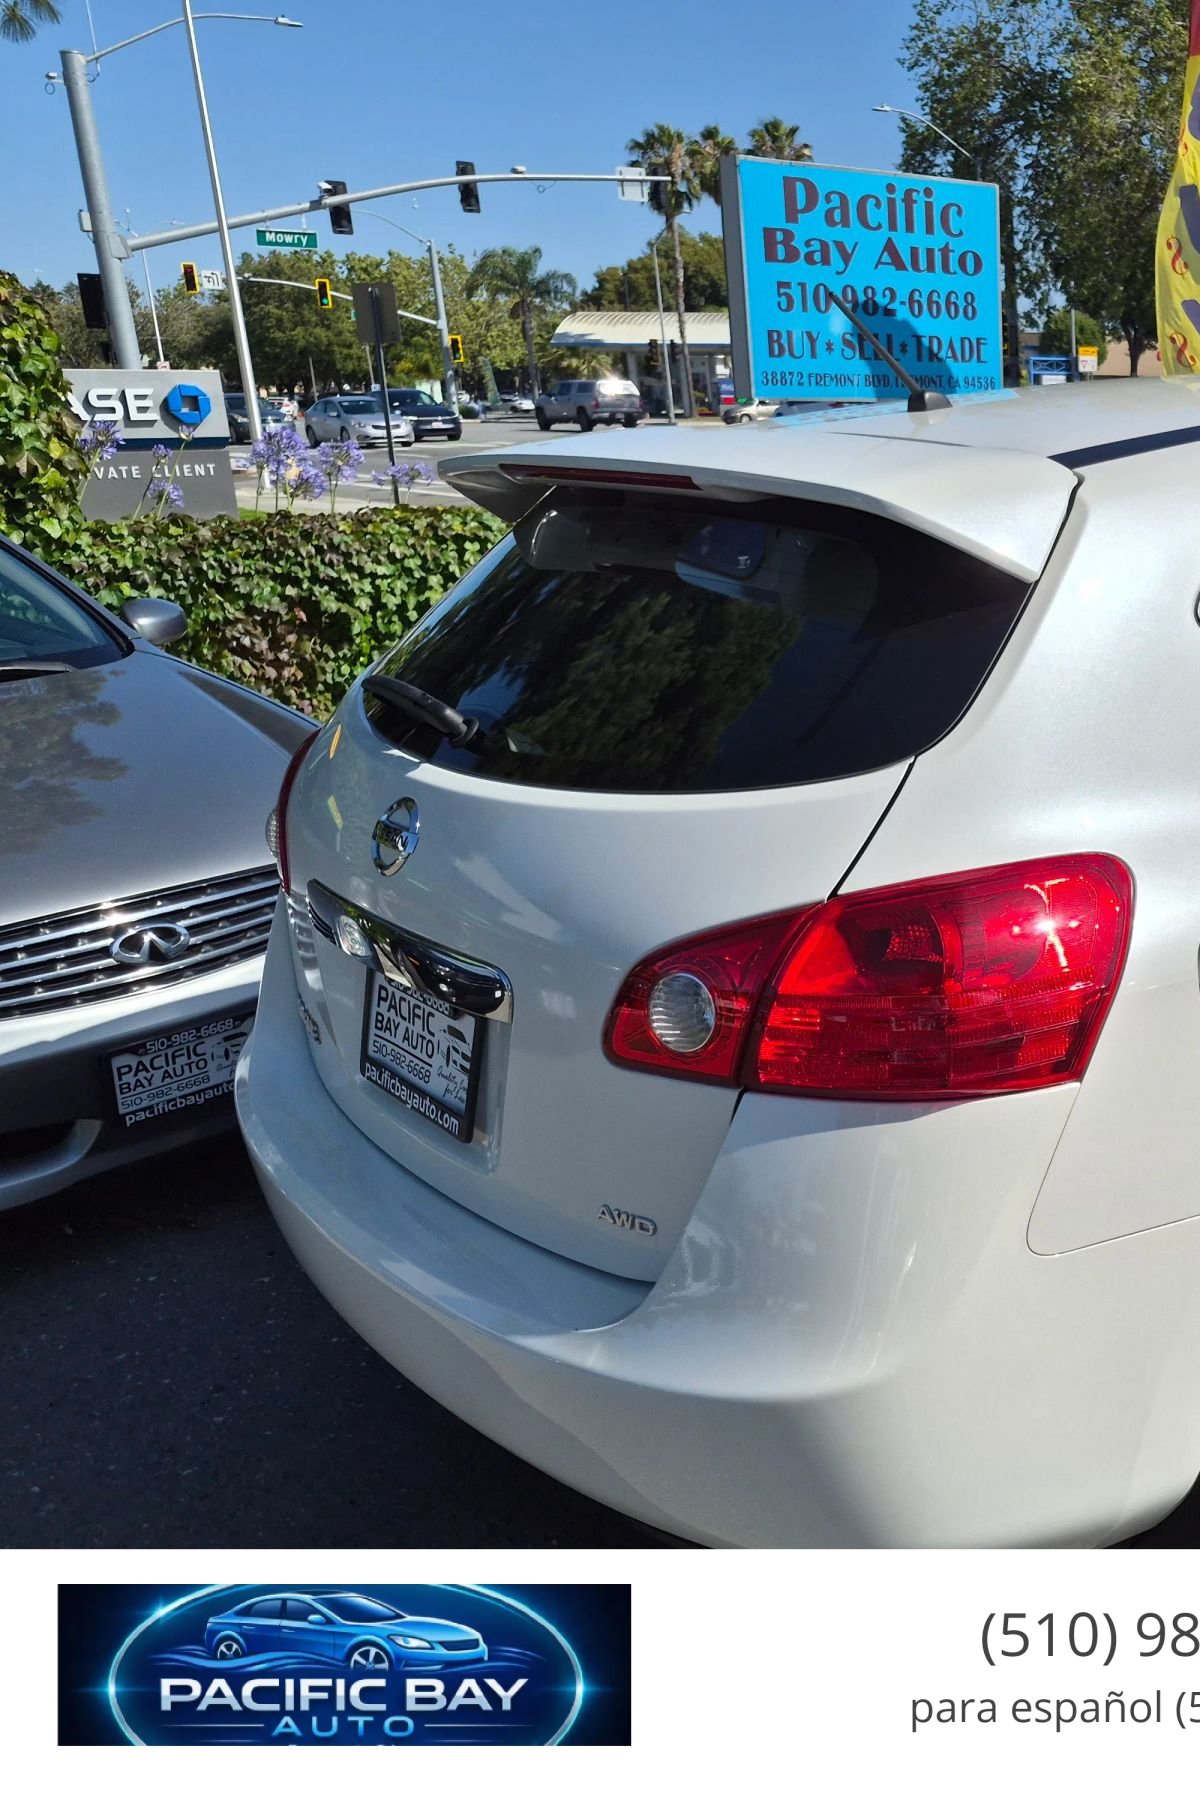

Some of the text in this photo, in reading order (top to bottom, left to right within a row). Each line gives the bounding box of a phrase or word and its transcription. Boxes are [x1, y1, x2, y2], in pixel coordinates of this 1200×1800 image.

[783, 176, 964, 238] Pacific
[265, 231, 308, 247] Mowry
[763, 227, 984, 277] Bay Auto
[776, 281, 978, 321] 510982-6668
[767, 329, 820, 359] BUY
[911, 334, 988, 364] TRADE
[762, 371, 804, 386] 38872
[808, 373, 860, 387] FREMONT
[964, 376, 996, 390] 94536
[94, 464, 215, 479] VATE CLIENT
[377, 984, 436, 1038] PACIFIC
[146, 1019, 234, 1054] 510-982-6668
[375, 1011, 435, 1059] BAY AUTO
[116, 1041, 207, 1081] PACIFIC
[118, 1074, 154, 1095] BAY
[161, 1057, 208, 1082] AUTO
[373, 1040, 432, 1084] 510-982-6668
[121, 1075, 210, 1110] 510-982-6668
[365, 1063, 461, 1135] pacificbayauto.com
[597, 1204, 657, 1236] AWD
